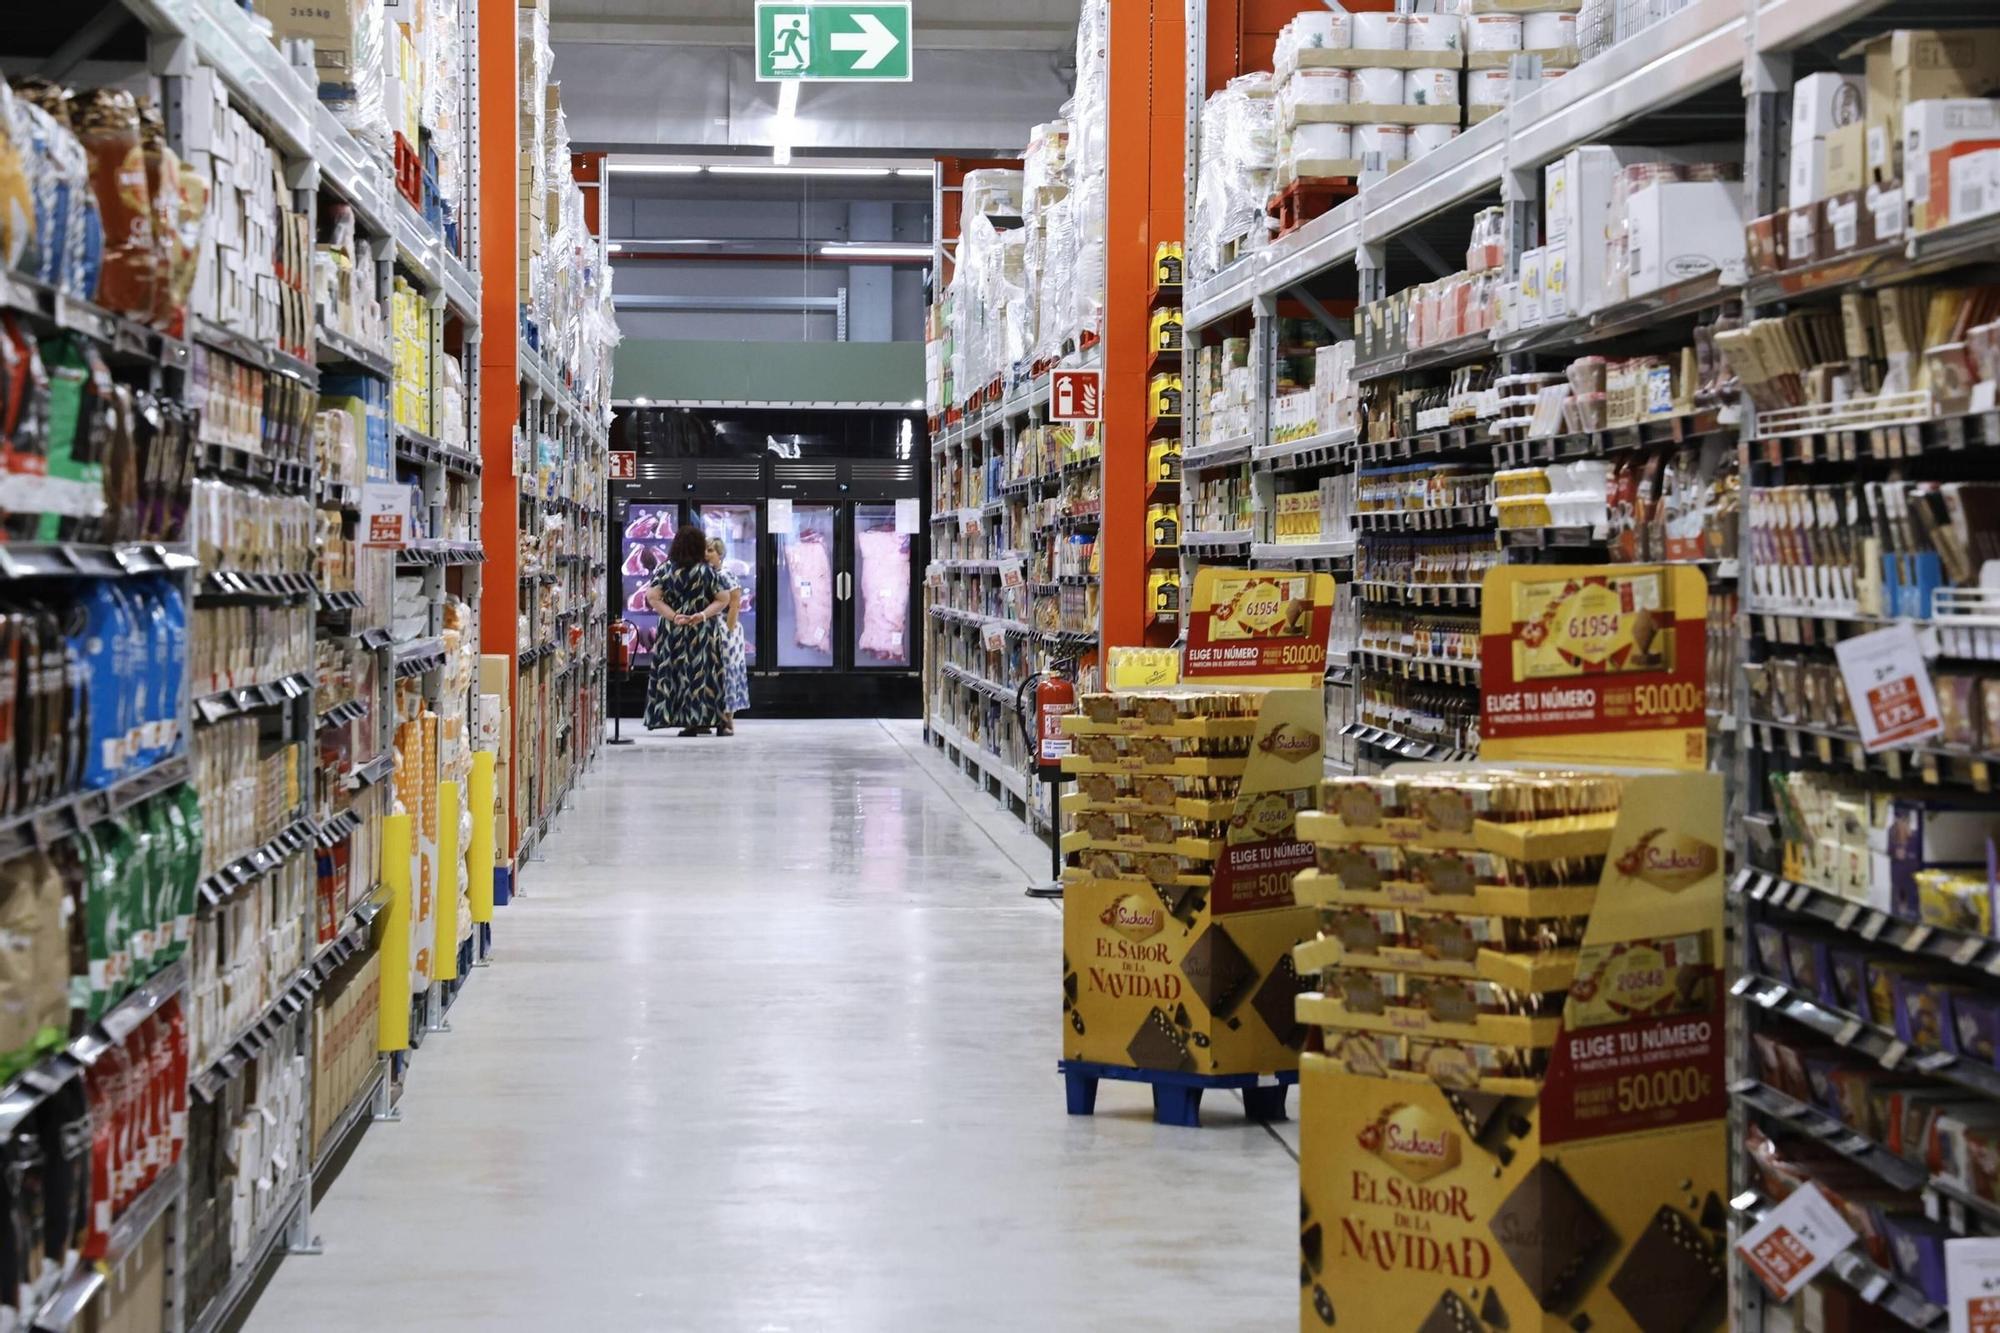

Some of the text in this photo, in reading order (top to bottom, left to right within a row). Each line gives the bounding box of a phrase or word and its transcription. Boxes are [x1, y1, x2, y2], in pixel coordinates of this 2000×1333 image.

[1246, 601, 1279, 616] 61954
[1568, 614, 1619, 638] 61954
[1189, 645, 1259, 660] ELIGE TU NÚMERO
[1486, 686, 1596, 713] ELIGE TU NÚMERO
[1275, 734, 1314, 750] Suchard
[1230, 842, 1314, 865] ELIGE TU NÚMERO
[1118, 907, 1156, 926] Suchard
[1096, 938, 1172, 965] EL SABOR
[1088, 967, 1182, 1000] NAVIDAD
[1570, 1022, 1712, 1060] ELIGE TU NÚMERO
[1387, 1123, 1448, 1157] Suchard
[1352, 1170, 1476, 1223] EL SABOR
[1340, 1216, 1492, 1281] NAVIDAD
